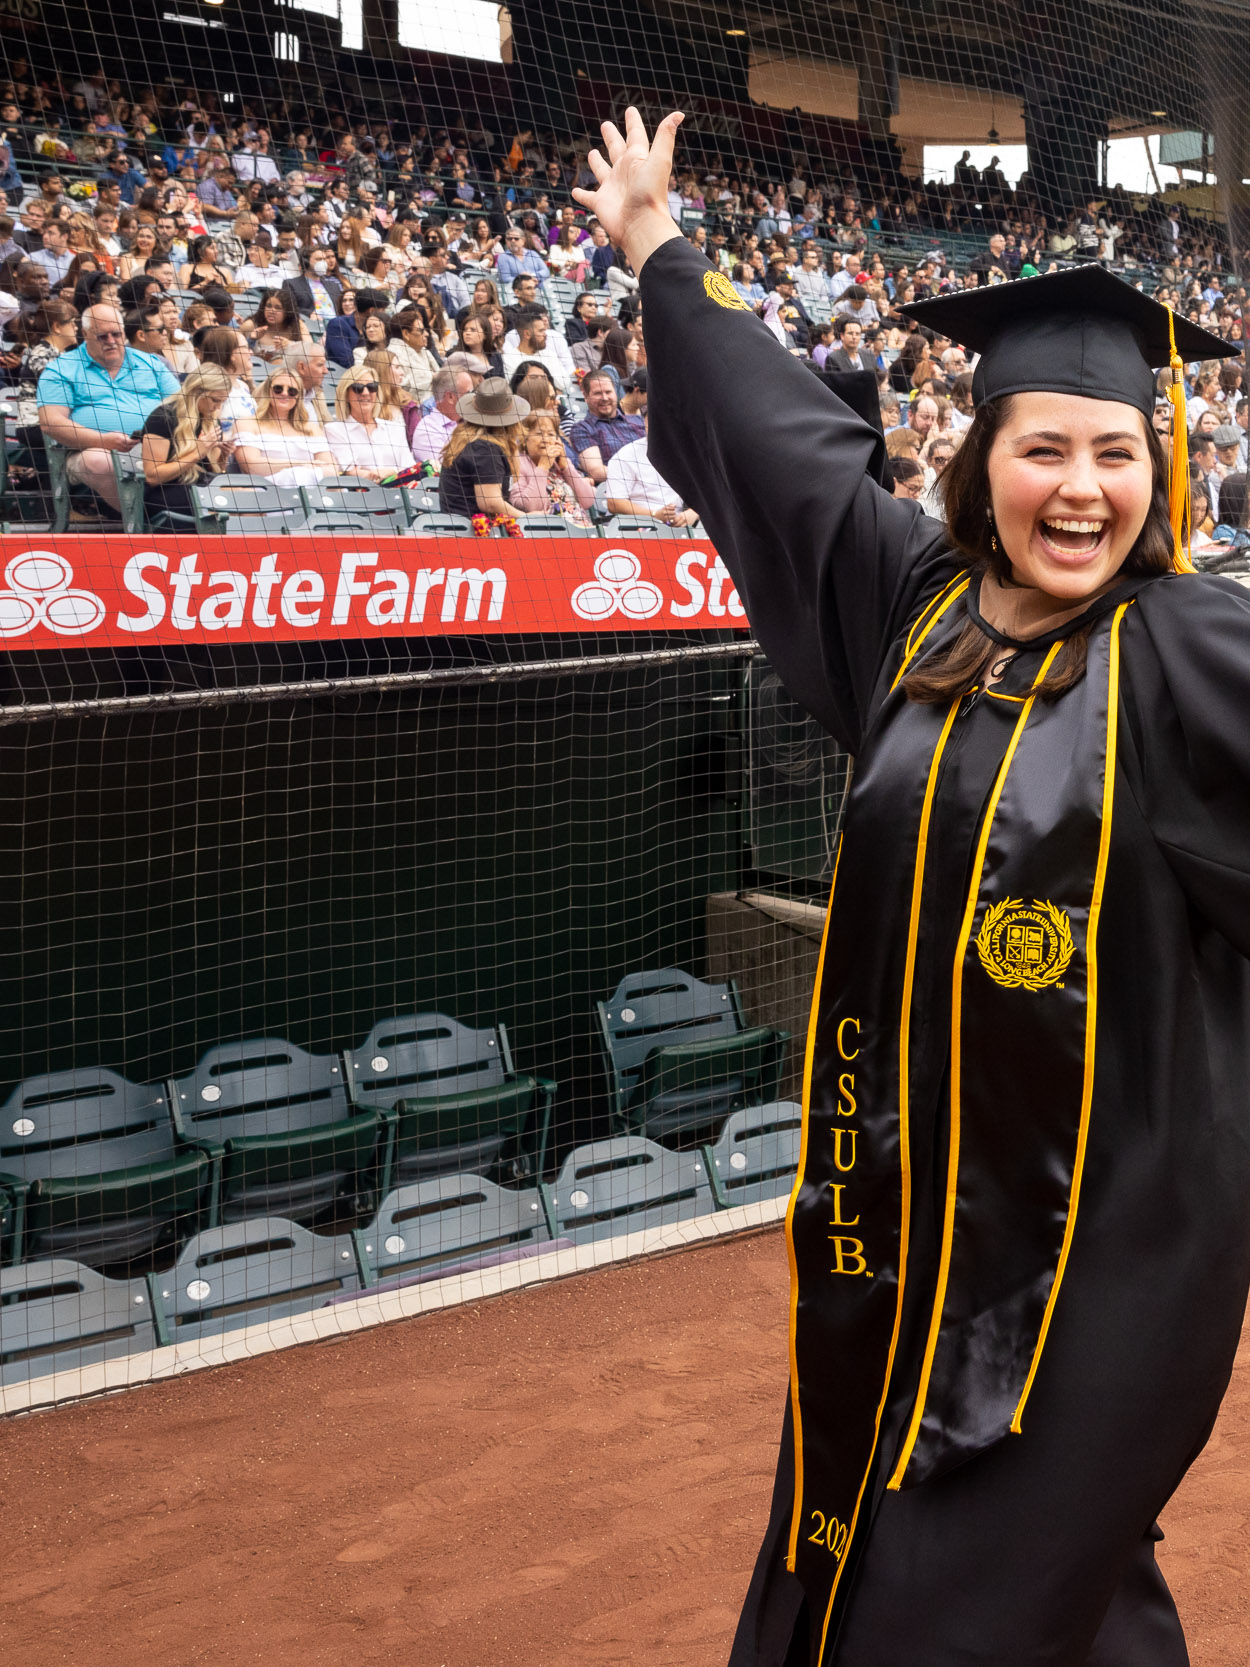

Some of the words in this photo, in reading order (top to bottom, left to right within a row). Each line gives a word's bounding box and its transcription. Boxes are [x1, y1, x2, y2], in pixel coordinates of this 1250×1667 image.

[992, 911, 1018, 963] CALIFORNIA
[1017, 910, 1043, 923] STATE
[1041, 917, 1058, 965] UNIVERSITY
[1000, 960, 1022, 977] LONG
[1022, 962, 1048, 977] BEACH
[827, 1017, 867, 1276] CSULB
